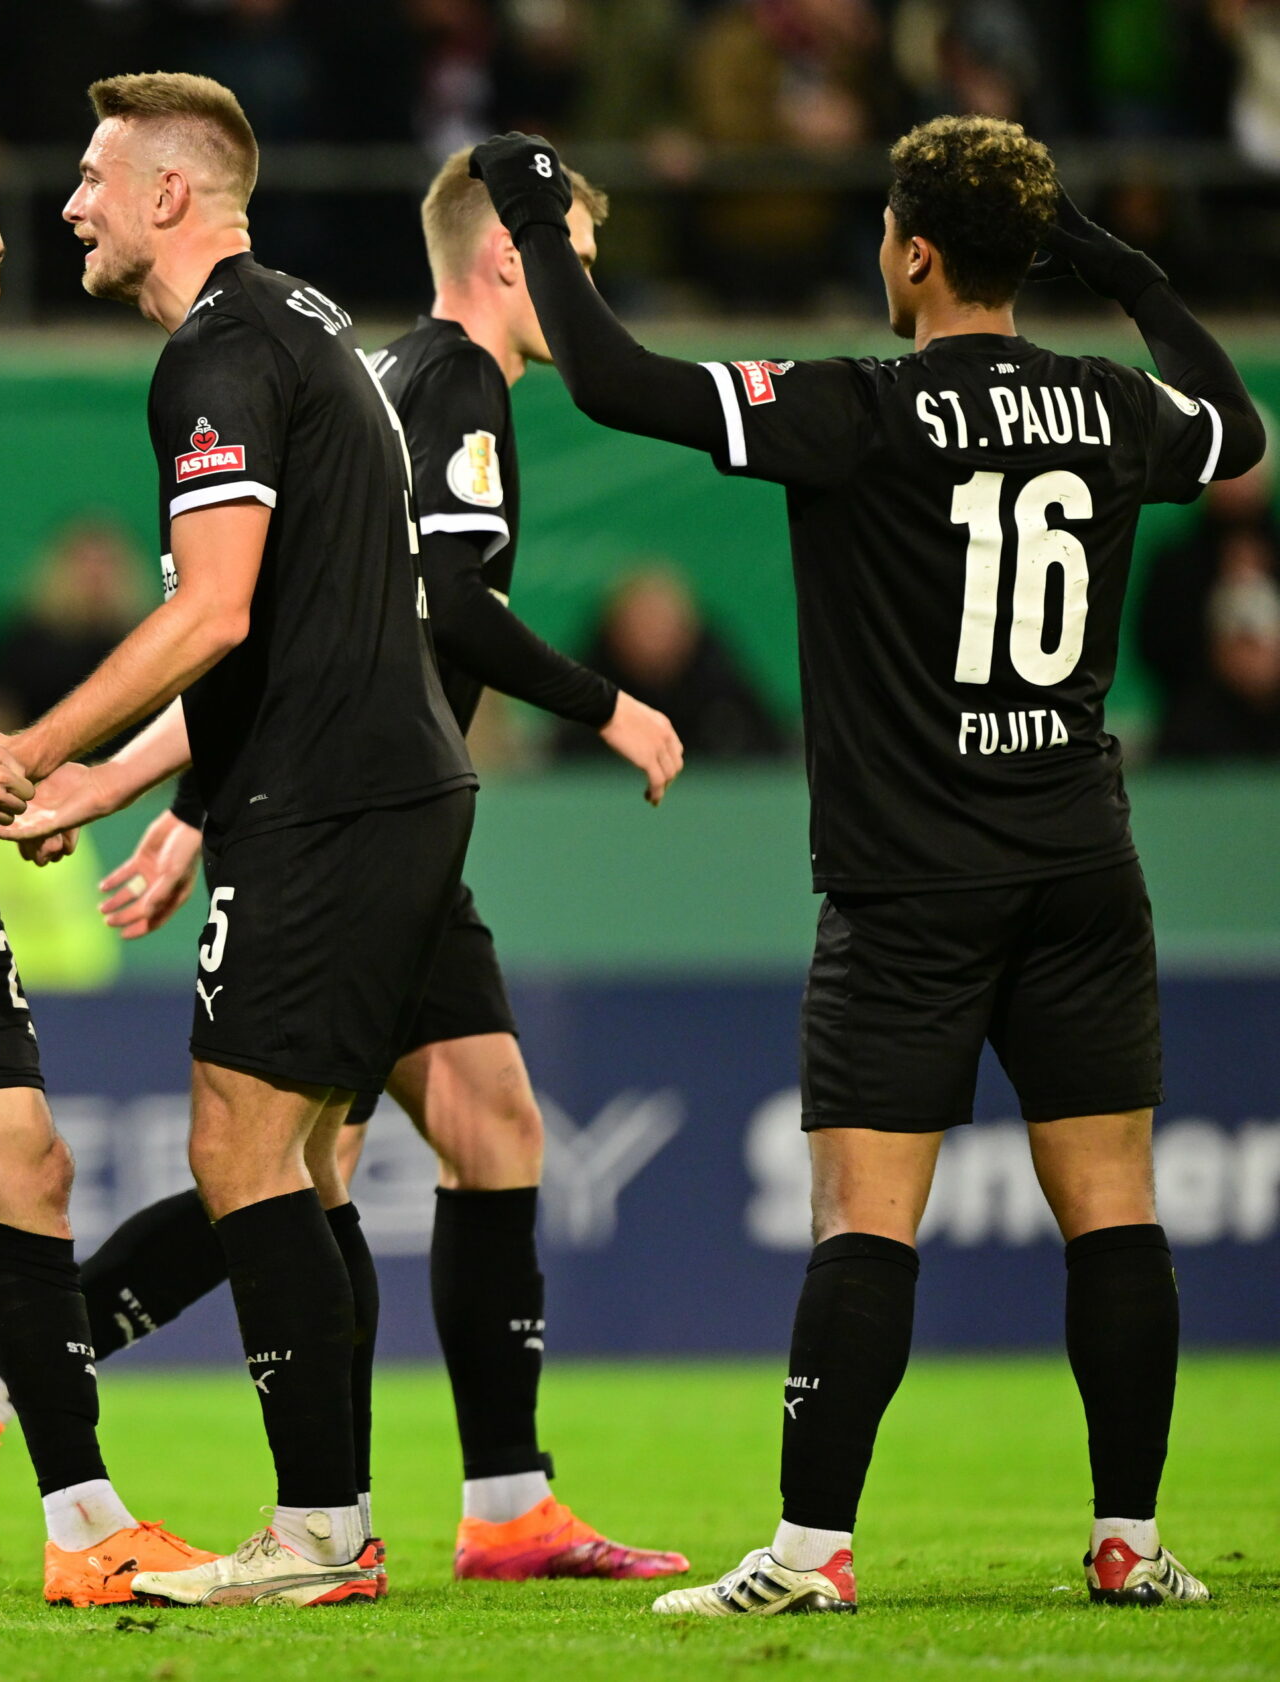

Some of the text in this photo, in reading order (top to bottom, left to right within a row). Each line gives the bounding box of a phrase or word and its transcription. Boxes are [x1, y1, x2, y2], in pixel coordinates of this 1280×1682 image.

[533, 152, 553, 178] 8
[915, 385, 1112, 449] ST. PAULI
[179, 451, 239, 475] ASTRA
[950, 470, 1094, 687] 16
[958, 709, 1069, 755] FUJITA
[199, 886, 236, 973] 5
[783, 1376, 820, 1390] AULI
